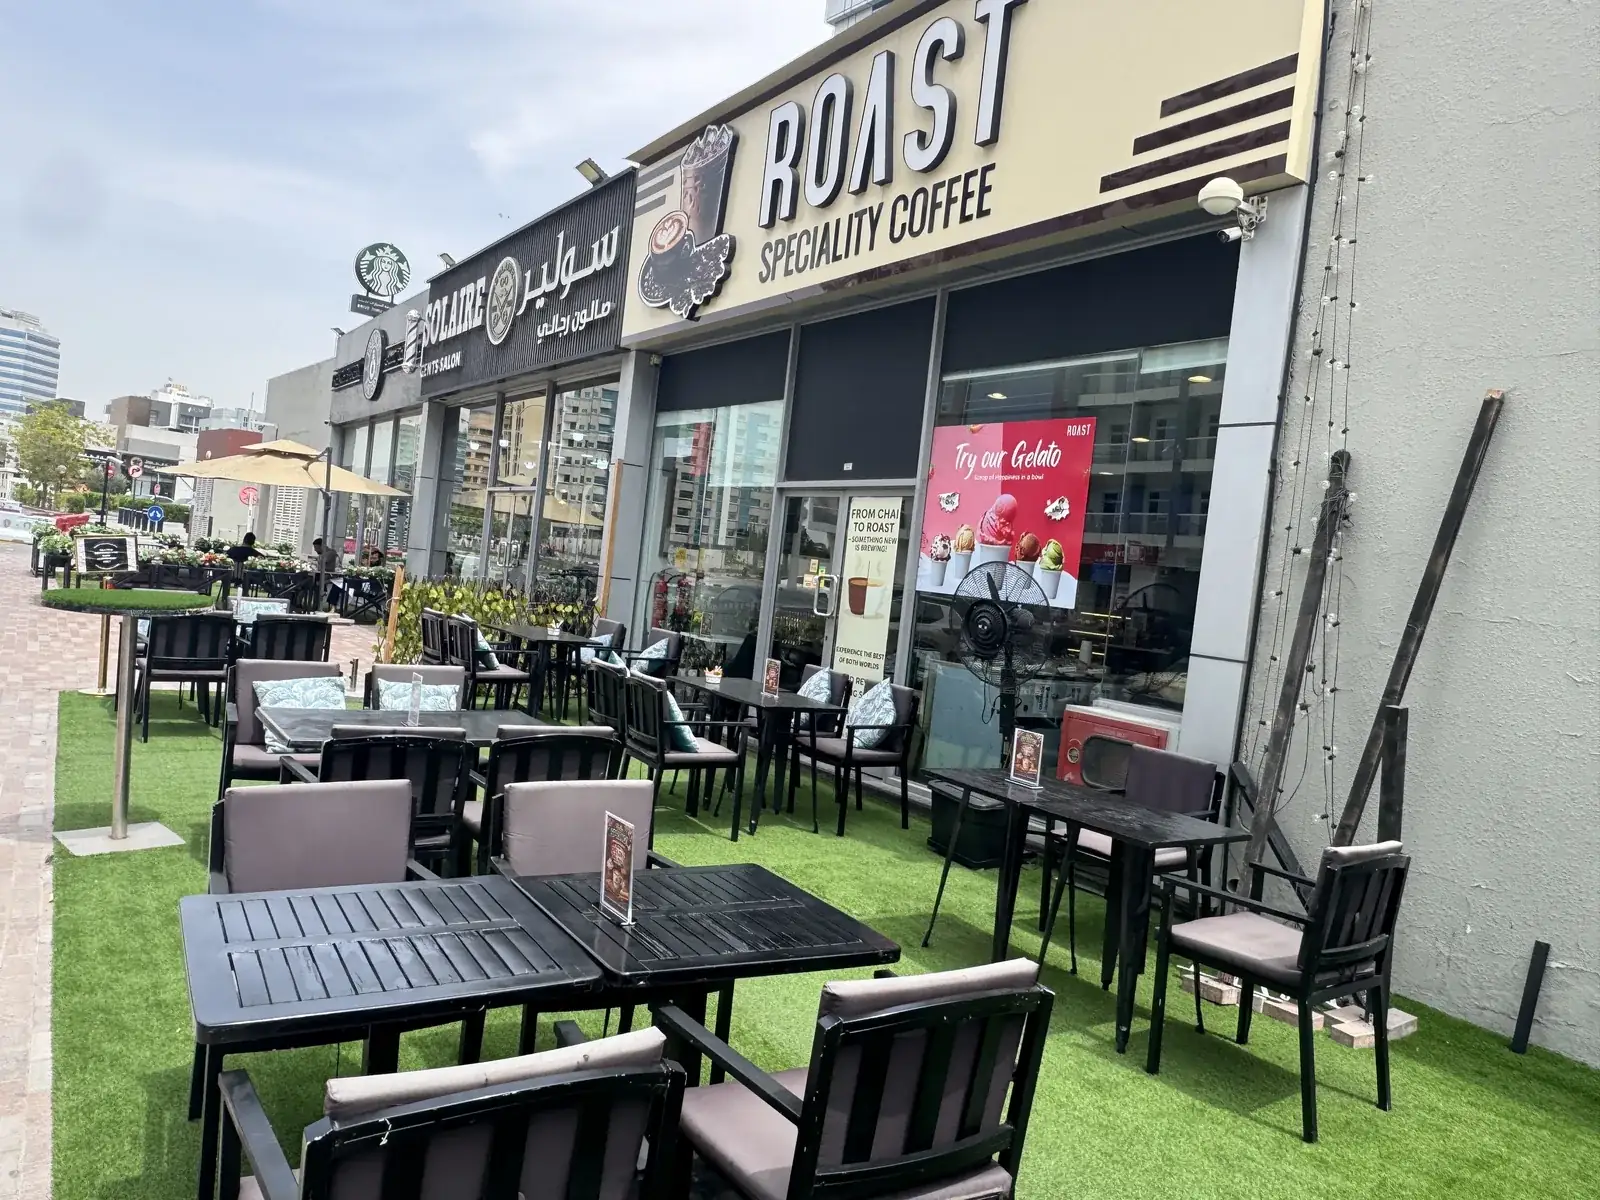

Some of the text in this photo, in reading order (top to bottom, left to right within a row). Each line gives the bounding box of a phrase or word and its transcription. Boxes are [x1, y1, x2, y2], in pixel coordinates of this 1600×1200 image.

[758, 0, 1028, 229] ROAST
[758, 162, 996, 284] SPECIALITY COFFEE
[516, 225, 619, 316] سولير
[422, 276, 486, 347] SOLAIRE
[537, 299, 611, 344] صالون رجالي
[420, 351, 461, 377] ENTS SALON
[1066, 424, 1091, 437] ROAST
[955, 439, 1061, 480] Try our Gelato
[851, 508, 900, 519] FROM CHAI
[853, 521, 895, 533] TO ROAST
[855, 544, 860, 552] IS
[883, 537, 898, 545] NEW
[836, 646, 885, 661] EXPERIENCE THE BEST
[845, 657, 859, 666] BOTH
[859, 660, 880, 670] WORLDS
